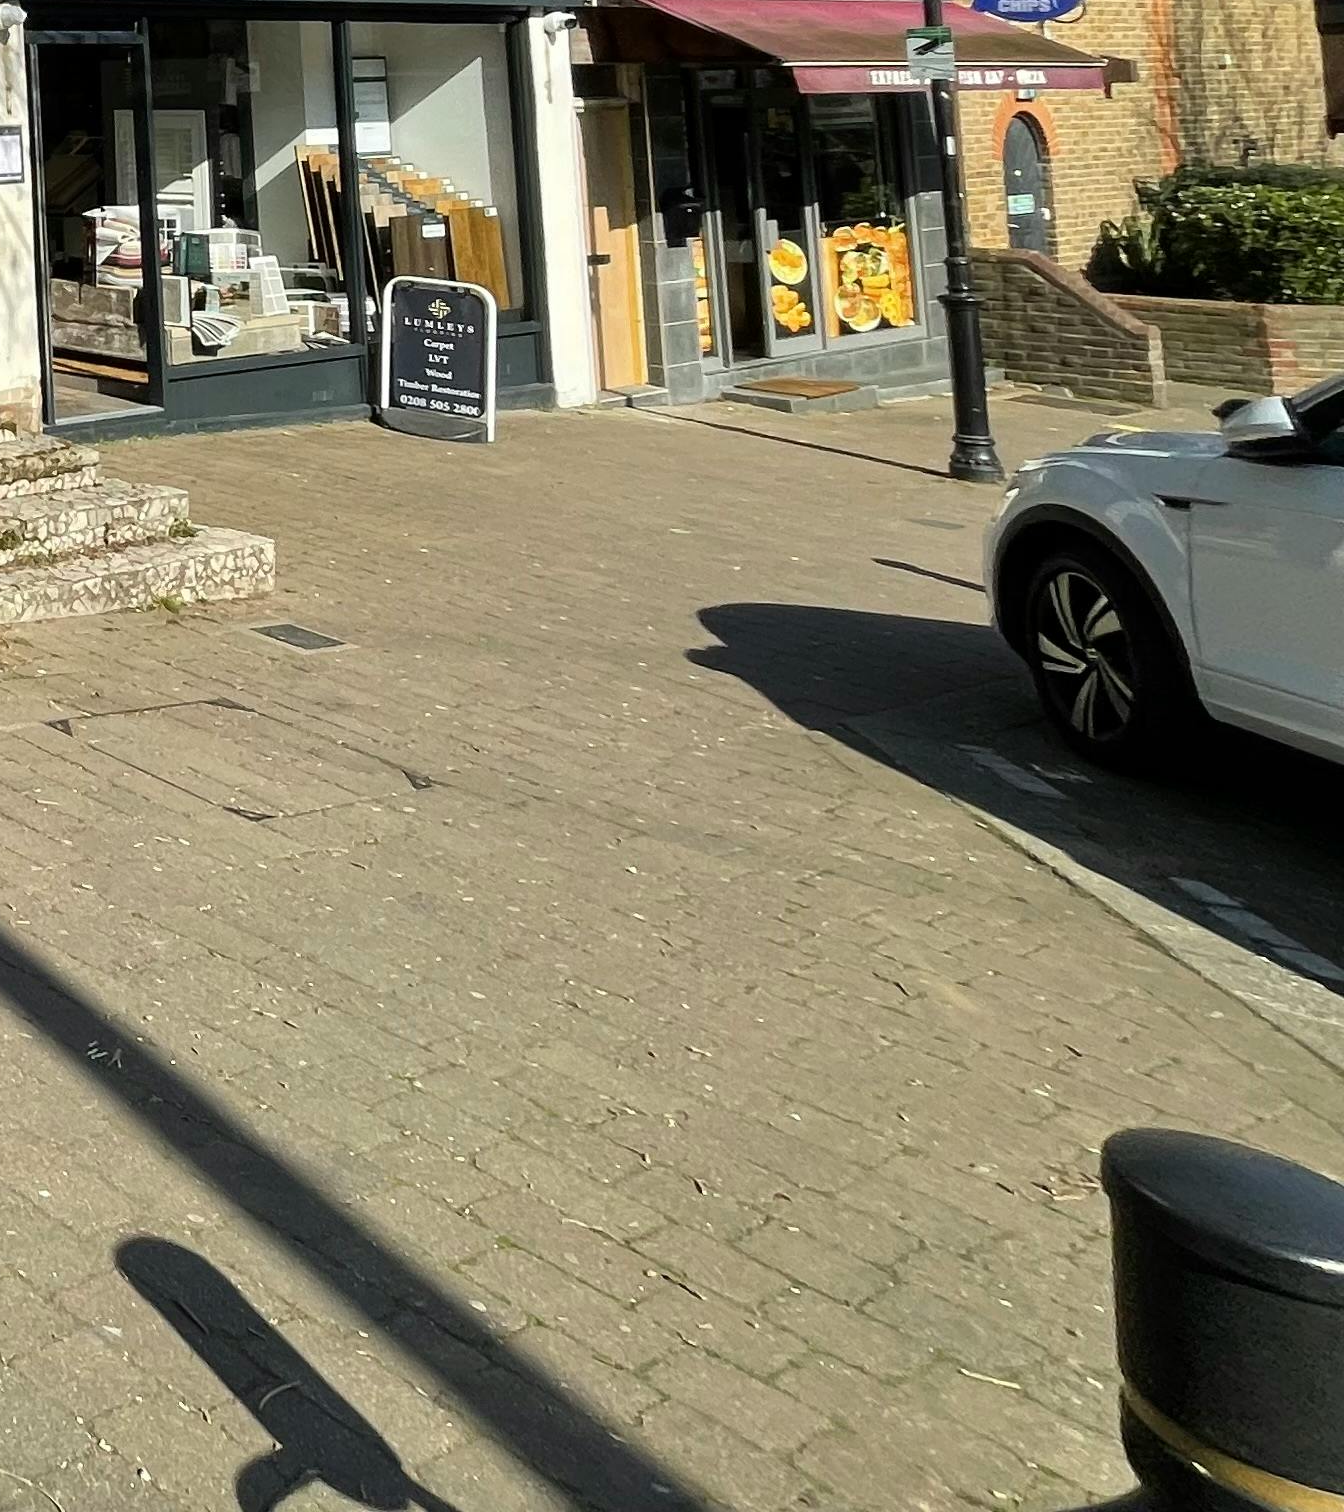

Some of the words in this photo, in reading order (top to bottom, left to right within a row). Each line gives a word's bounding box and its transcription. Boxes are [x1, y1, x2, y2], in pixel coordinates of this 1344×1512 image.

[404, 317, 475, 334] LUMLEYS
[423, 339, 454, 351] Carpet
[428, 353, 449, 365] LVT
[425, 368, 453, 380] Wood
[398, 378, 429, 391] Timber
[431, 384, 481, 399] Restoration
[400, 394, 427, 407] 0208
[429, 399, 451, 412] 505
[453, 403, 481, 417] 2800
